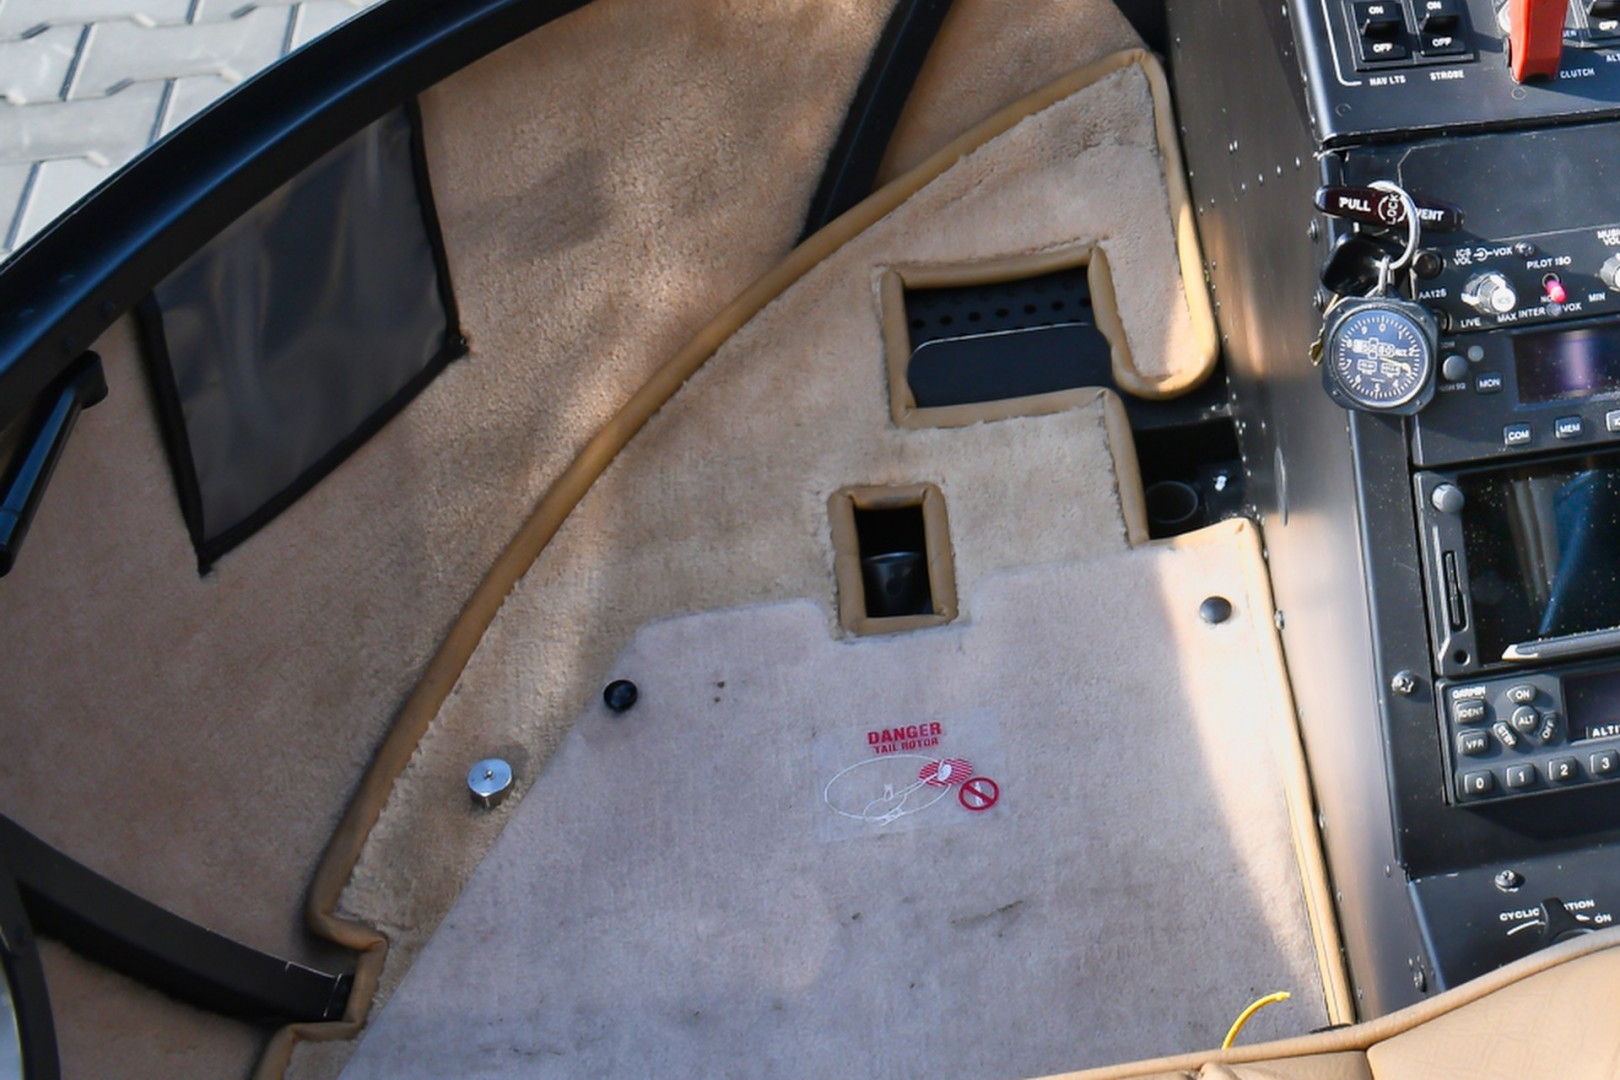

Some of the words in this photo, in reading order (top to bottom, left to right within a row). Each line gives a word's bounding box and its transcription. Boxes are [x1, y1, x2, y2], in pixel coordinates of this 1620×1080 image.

[1369, 6, 1383, 14] ON
[1427, 1, 1442, 10] ON
[1373, 43, 1393, 52] OFF
[1432, 38, 1452, 47] OFF
[1430, 71, 1464, 80] STROBE
[1560, 69, 1594, 79] CLUTCH
[1369, 76, 1388, 86] NAV
[1390, 75, 1405, 84] LTS
[1339, 197, 1371, 212] PULL
[1387, 195, 1400, 225] LOCK
[1493, 247, 1512, 256] VOX
[1527, 258, 1552, 269] PILOT
[1519, 307, 1545, 318] INTER
[1564, 303, 1582, 312] VOX
[1460, 318, 1481, 327] LIVE
[1479, 378, 1499, 387] MON
[1508, 430, 1529, 440] COM
[1452, 686, 1486, 699] GARMIN
[1516, 689, 1530, 700] ON
[1518, 716, 1534, 725] ALT
[867, 722, 942, 745] DANGER
[874, 745, 898, 754] TAIL
[901, 737, 938, 749] ROTOR
[1466, 739, 1484, 749] VFR
[1561, 764, 1568, 775] 2
[1500, 908, 1539, 921] CYCLIC
[1595, 913, 1611, 923] ON
